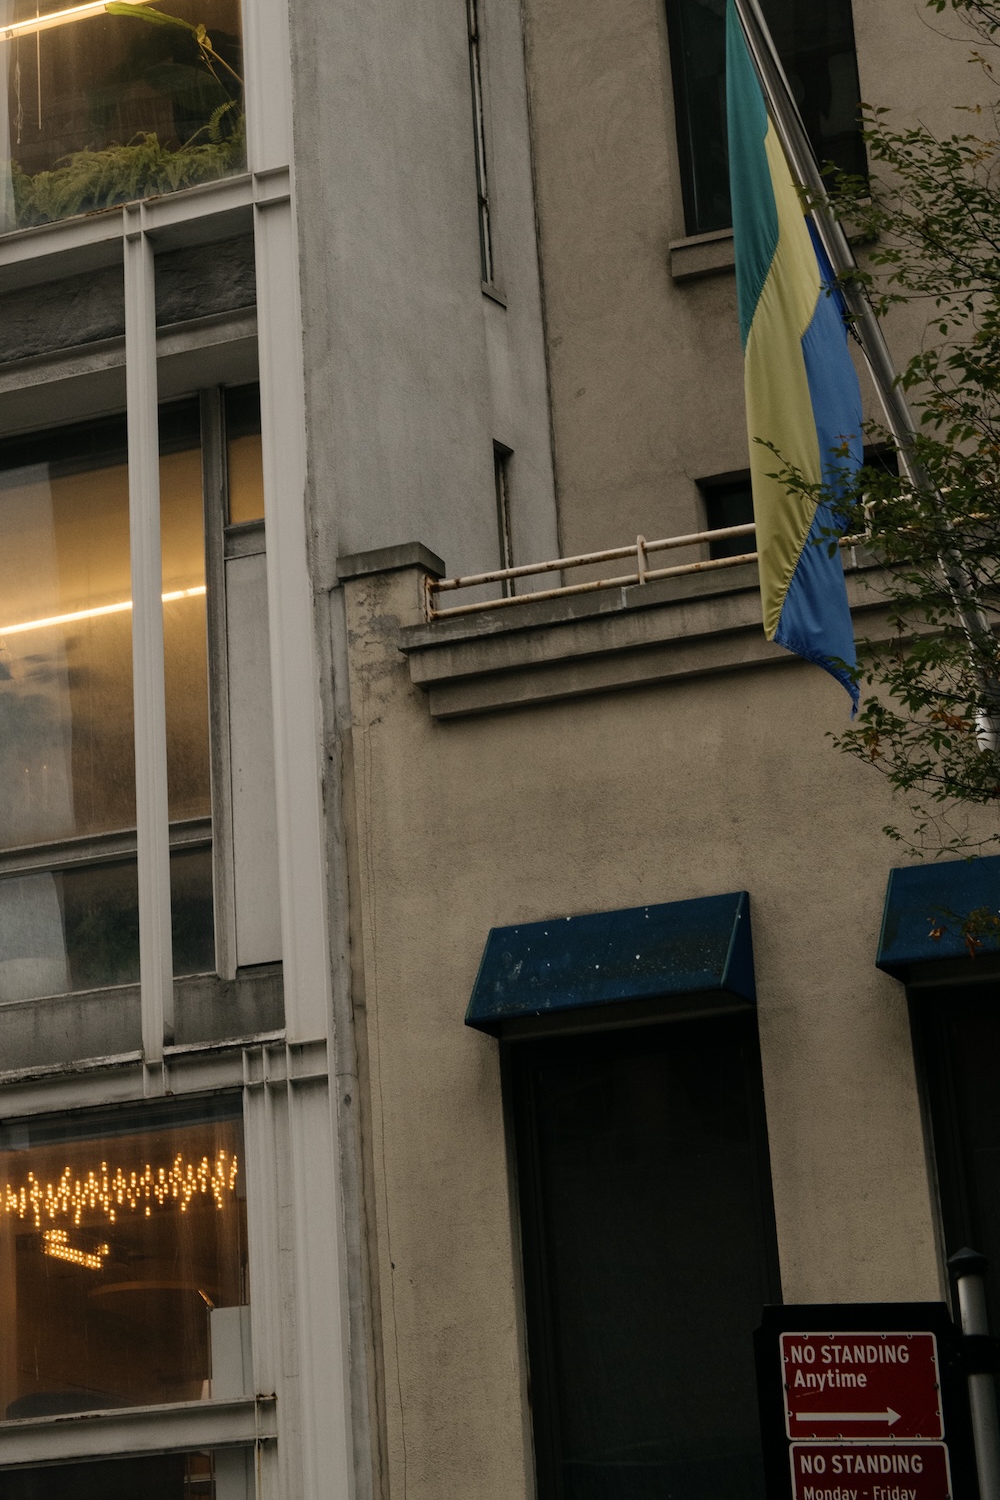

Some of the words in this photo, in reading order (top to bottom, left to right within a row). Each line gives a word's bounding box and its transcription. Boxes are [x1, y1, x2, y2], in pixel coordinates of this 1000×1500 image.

[790, 1345, 816, 1364] NO
[820, 1344, 910, 1364] STANDING
[794, 1369, 867, 1392] Anytime
[800, 1455, 826, 1474] NO
[831, 1454, 923, 1474] STANDING
[803, 1486, 858, 1500] Monday
[873, 1485, 916, 1500] Friday
